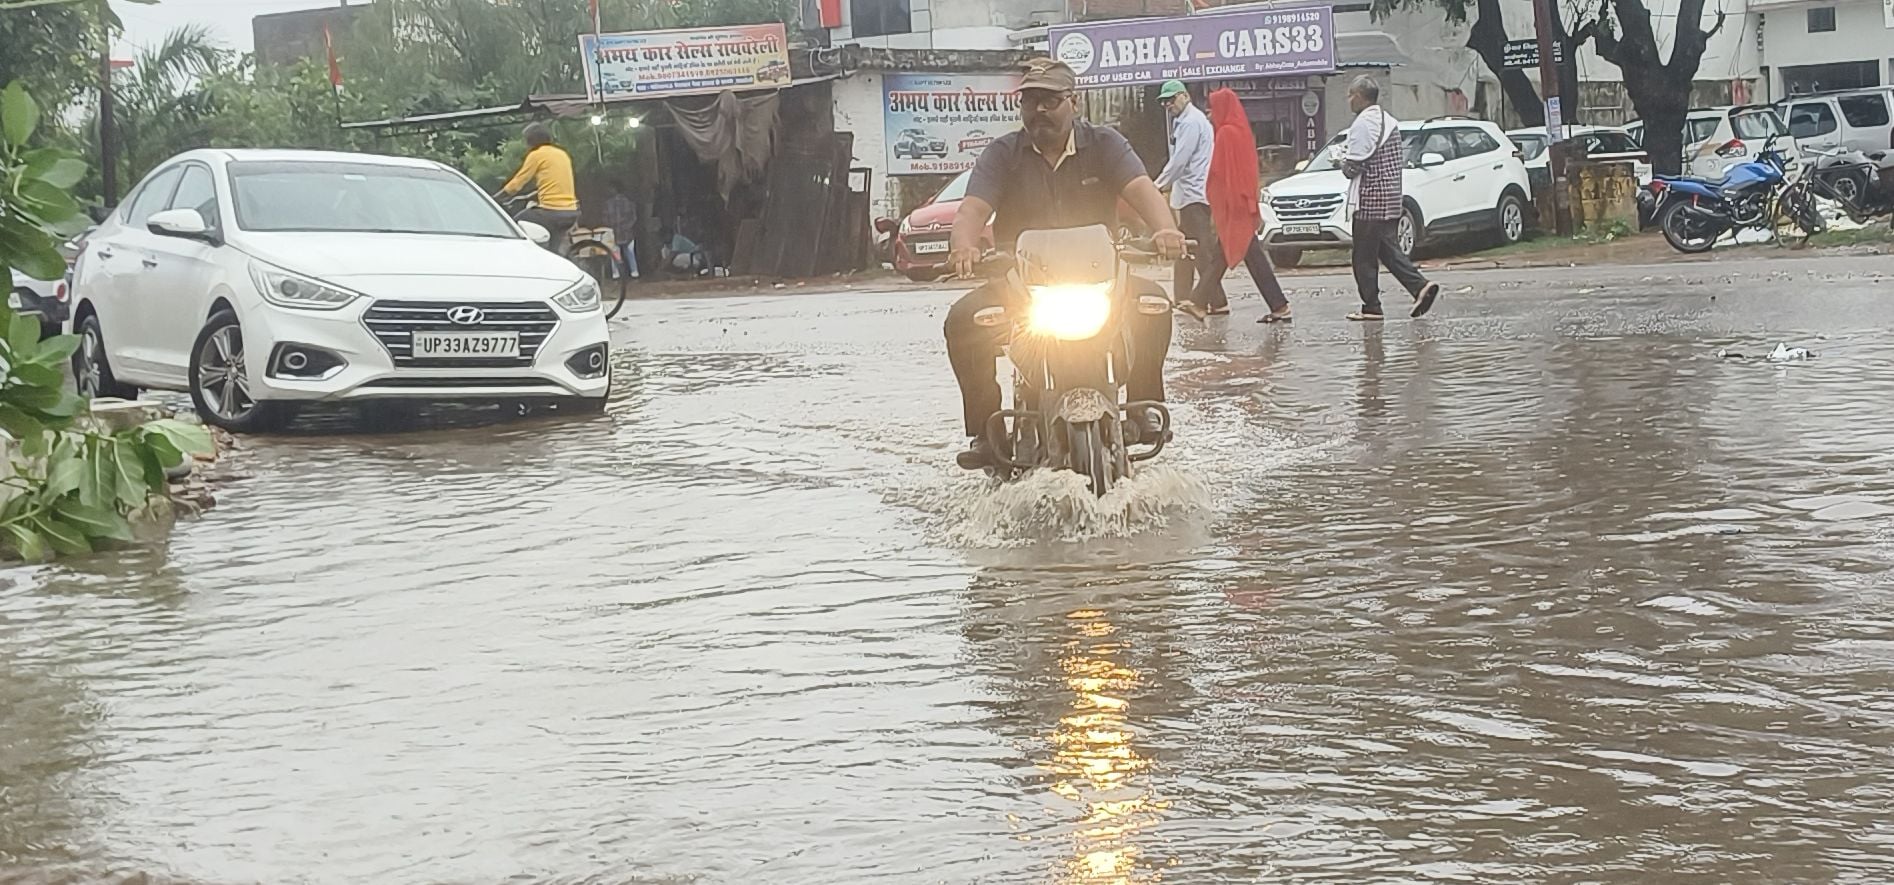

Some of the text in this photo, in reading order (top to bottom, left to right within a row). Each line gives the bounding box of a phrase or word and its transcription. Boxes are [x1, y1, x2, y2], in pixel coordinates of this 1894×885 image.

[640, 46, 672, 61] कार
[1100, 34, 1193, 68] ABHAY
[1218, 24, 1323, 58] CARS33
[1206, 64, 1246, 75] EXCHANGE
[1074, 71, 1152, 85] TYPES OF USED CAR
[931, 92, 960, 112] कार
[963, 86, 998, 112] सेल्स
[423, 337, 517, 353] UP33AZ9777
